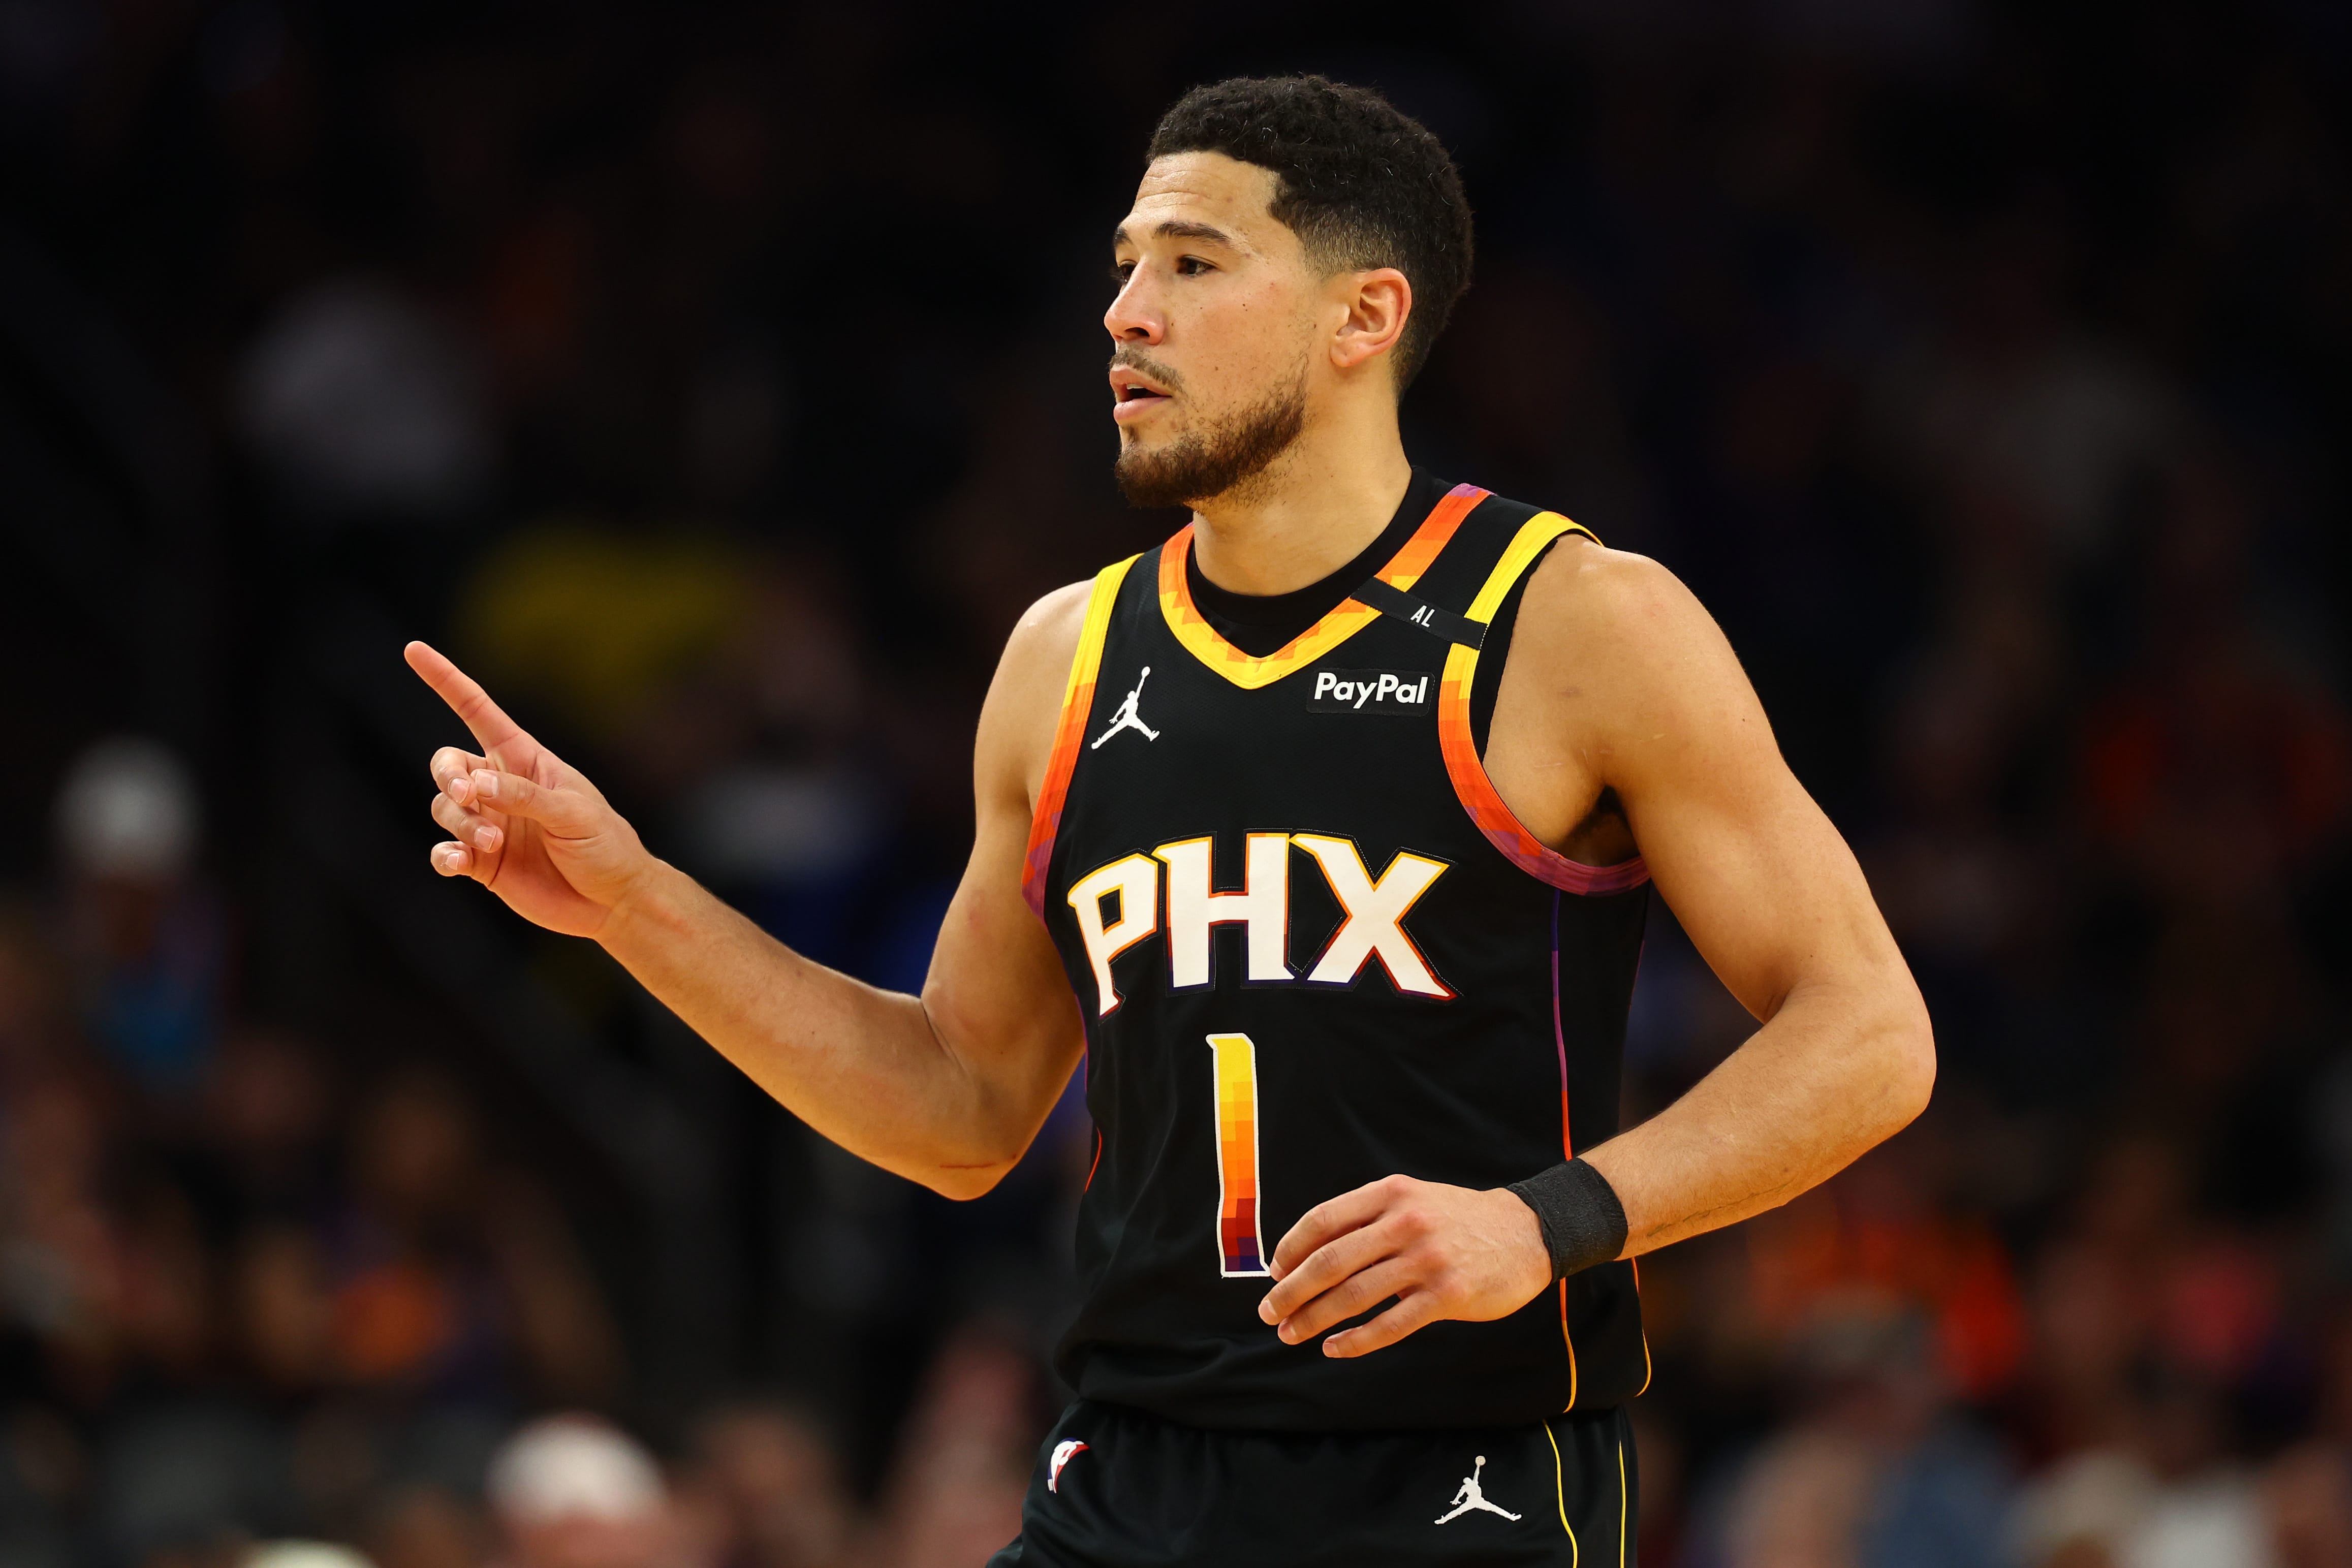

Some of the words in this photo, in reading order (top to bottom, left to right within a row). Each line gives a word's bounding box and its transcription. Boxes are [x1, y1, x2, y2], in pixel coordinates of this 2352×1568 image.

[1410, 605, 1435, 628] AL
[1314, 672, 1429, 709] PayPal
[1067, 832, 1458, 1017] PHX
[1205, 1032, 1271, 1278] 1
